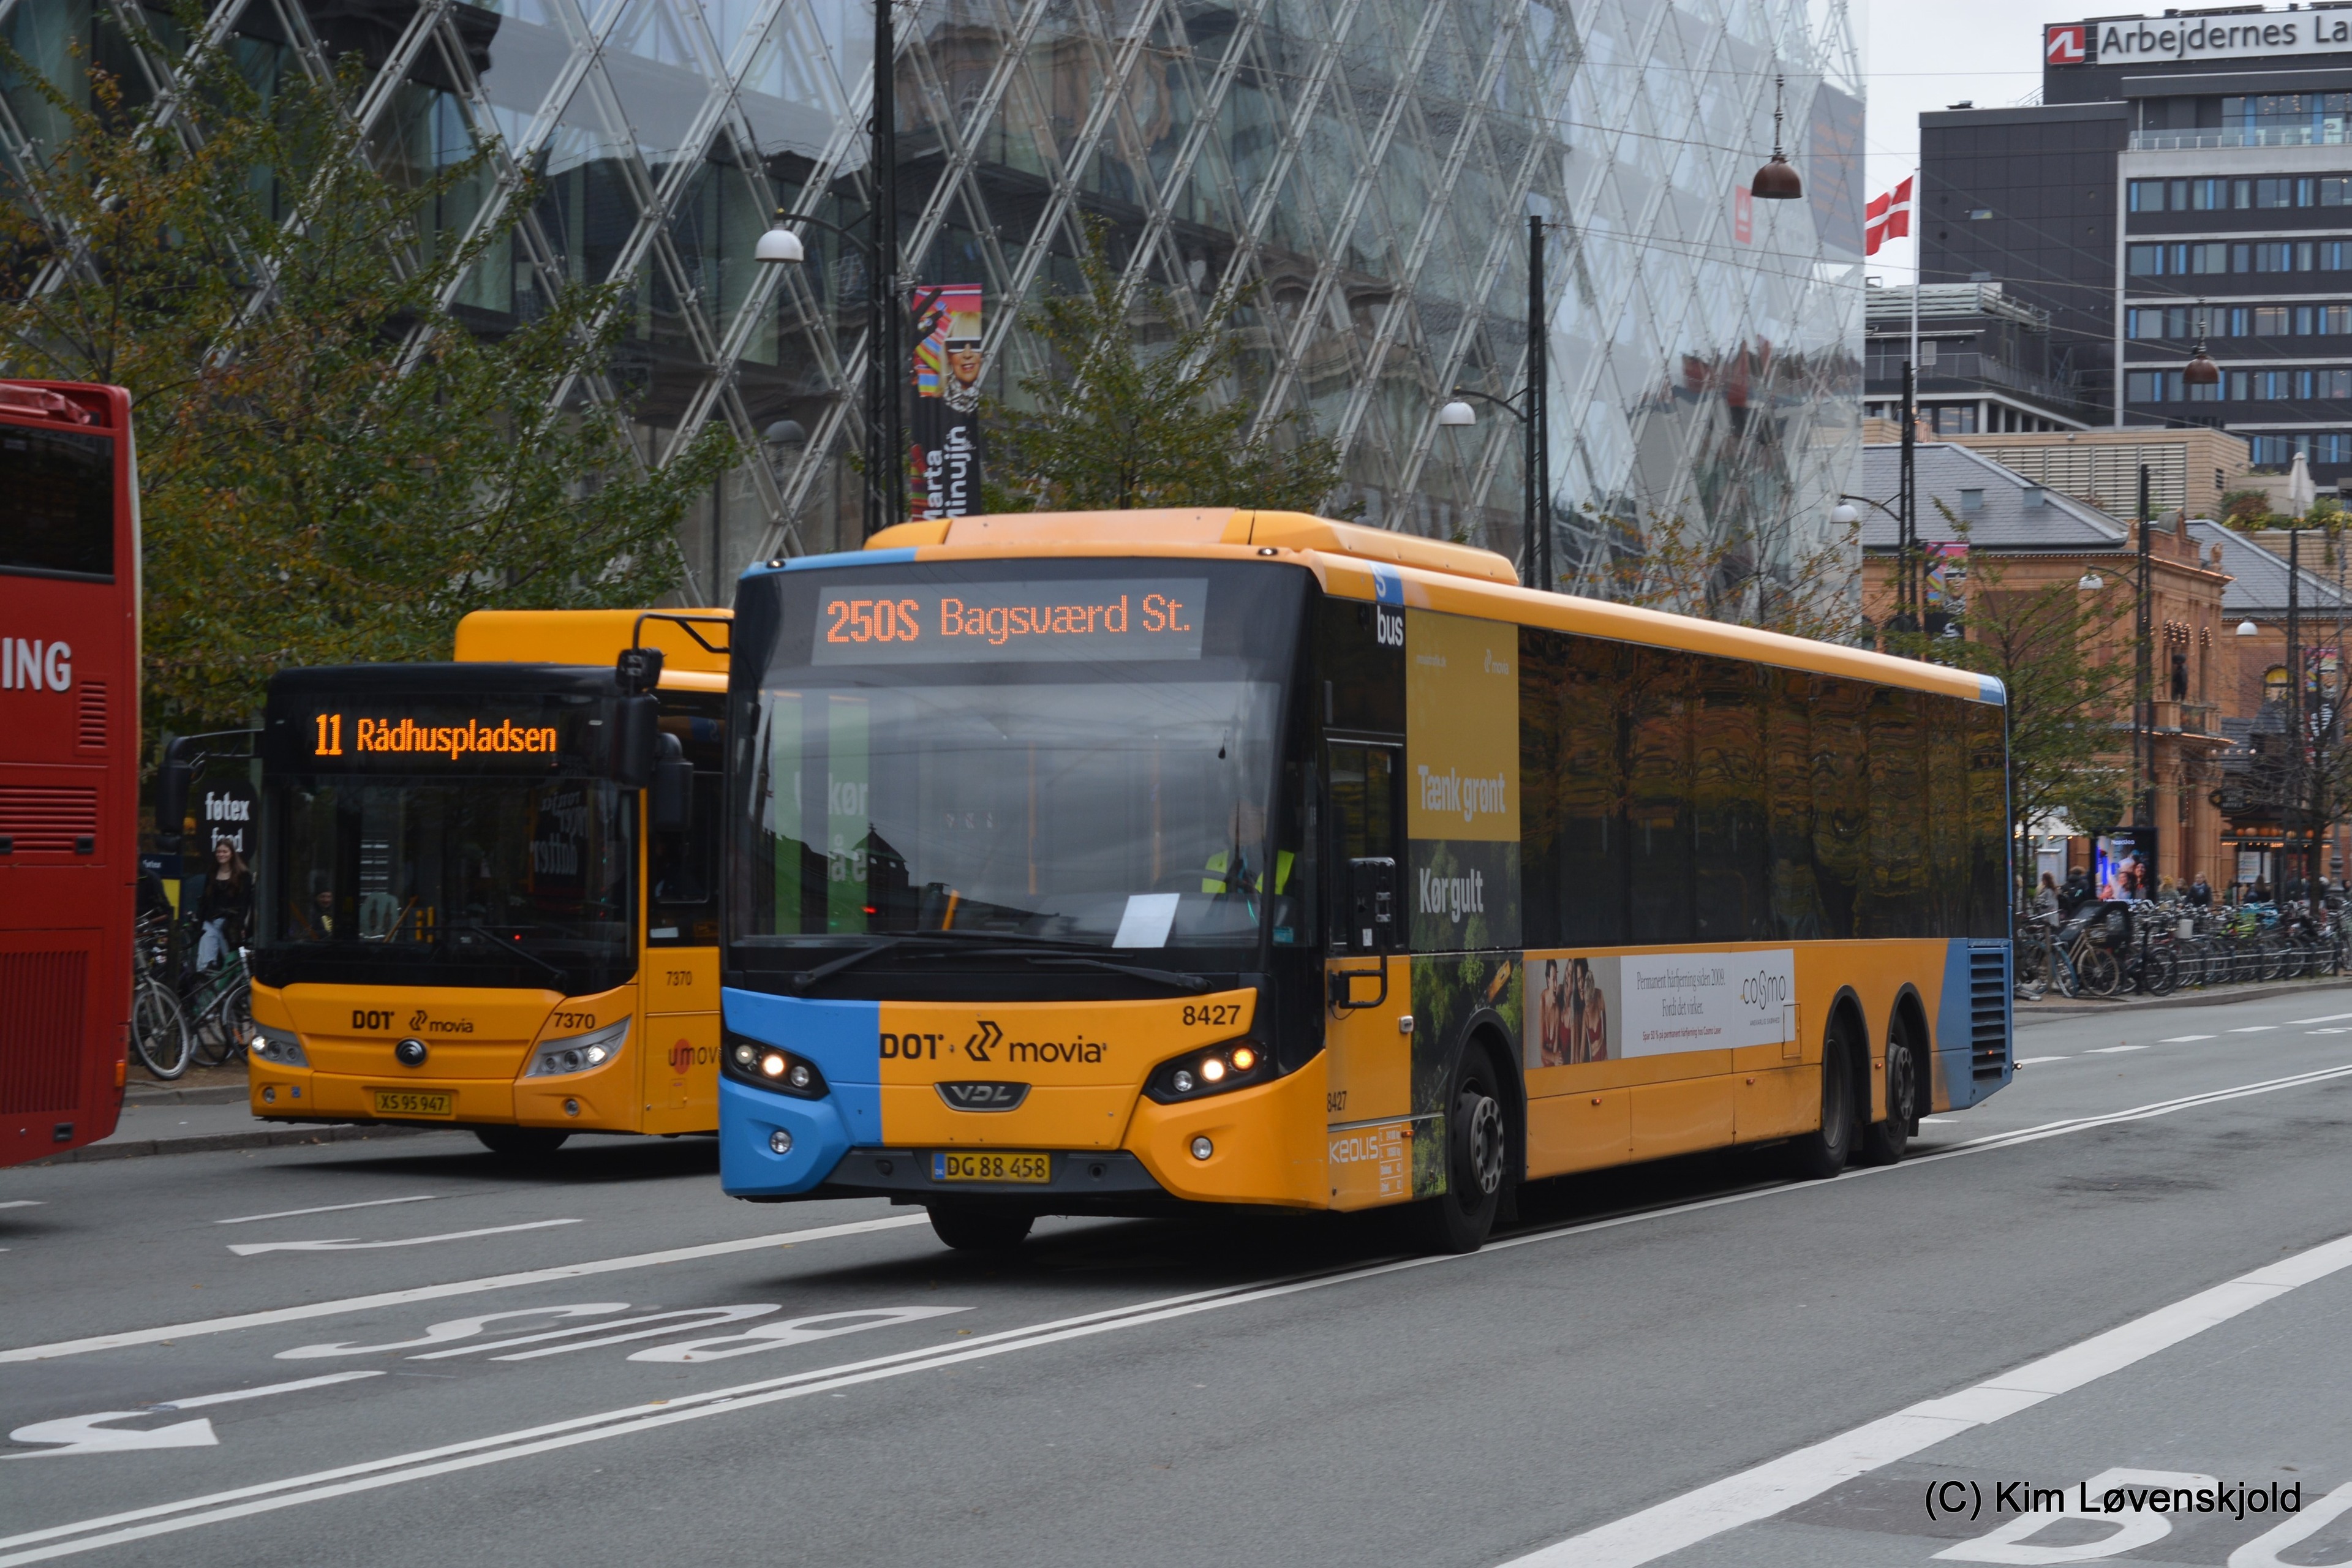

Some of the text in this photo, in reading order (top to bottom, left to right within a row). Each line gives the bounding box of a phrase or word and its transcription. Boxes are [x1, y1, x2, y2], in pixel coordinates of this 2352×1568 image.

[2101, 18, 2297, 58] Arbejdernes
[827, 594, 1190, 645] 250S Bagsværd St.
[1377, 605, 1404, 647] bus
[1, 637, 72, 692] ING
[315, 714, 557, 760] 11 Rådhuspladsen
[205, 791, 250, 821] føtex
[1418, 764, 1506, 823] Tænk grønt
[211, 827, 243, 853] fd
[1419, 867, 1484, 923] Kør gult
[666, 971, 692, 986] 7370
[1637, 968, 1725, 992] Permanent hårfjerning siden 2009.
[1743, 970, 1786, 1010] cosmo
[1182, 1005, 1242, 1026] 8427
[1662, 995, 1703, 1017] Fordi det virker.
[352, 1010, 474, 1033] DOT movia
[553, 1012, 595, 1029] 7370
[668, 1046, 722, 1067] umov
[880, 1033, 1101, 1063] DOT movia
[380, 1095, 445, 1112] XS 95 947
[950, 1085, 1012, 1102] VDL
[1327, 1091, 1347, 1113] 8427
[947, 1156, 974, 1177] DG
[980, 1157, 1004, 1177] 88
[1010, 1158, 1046, 1178] 458
